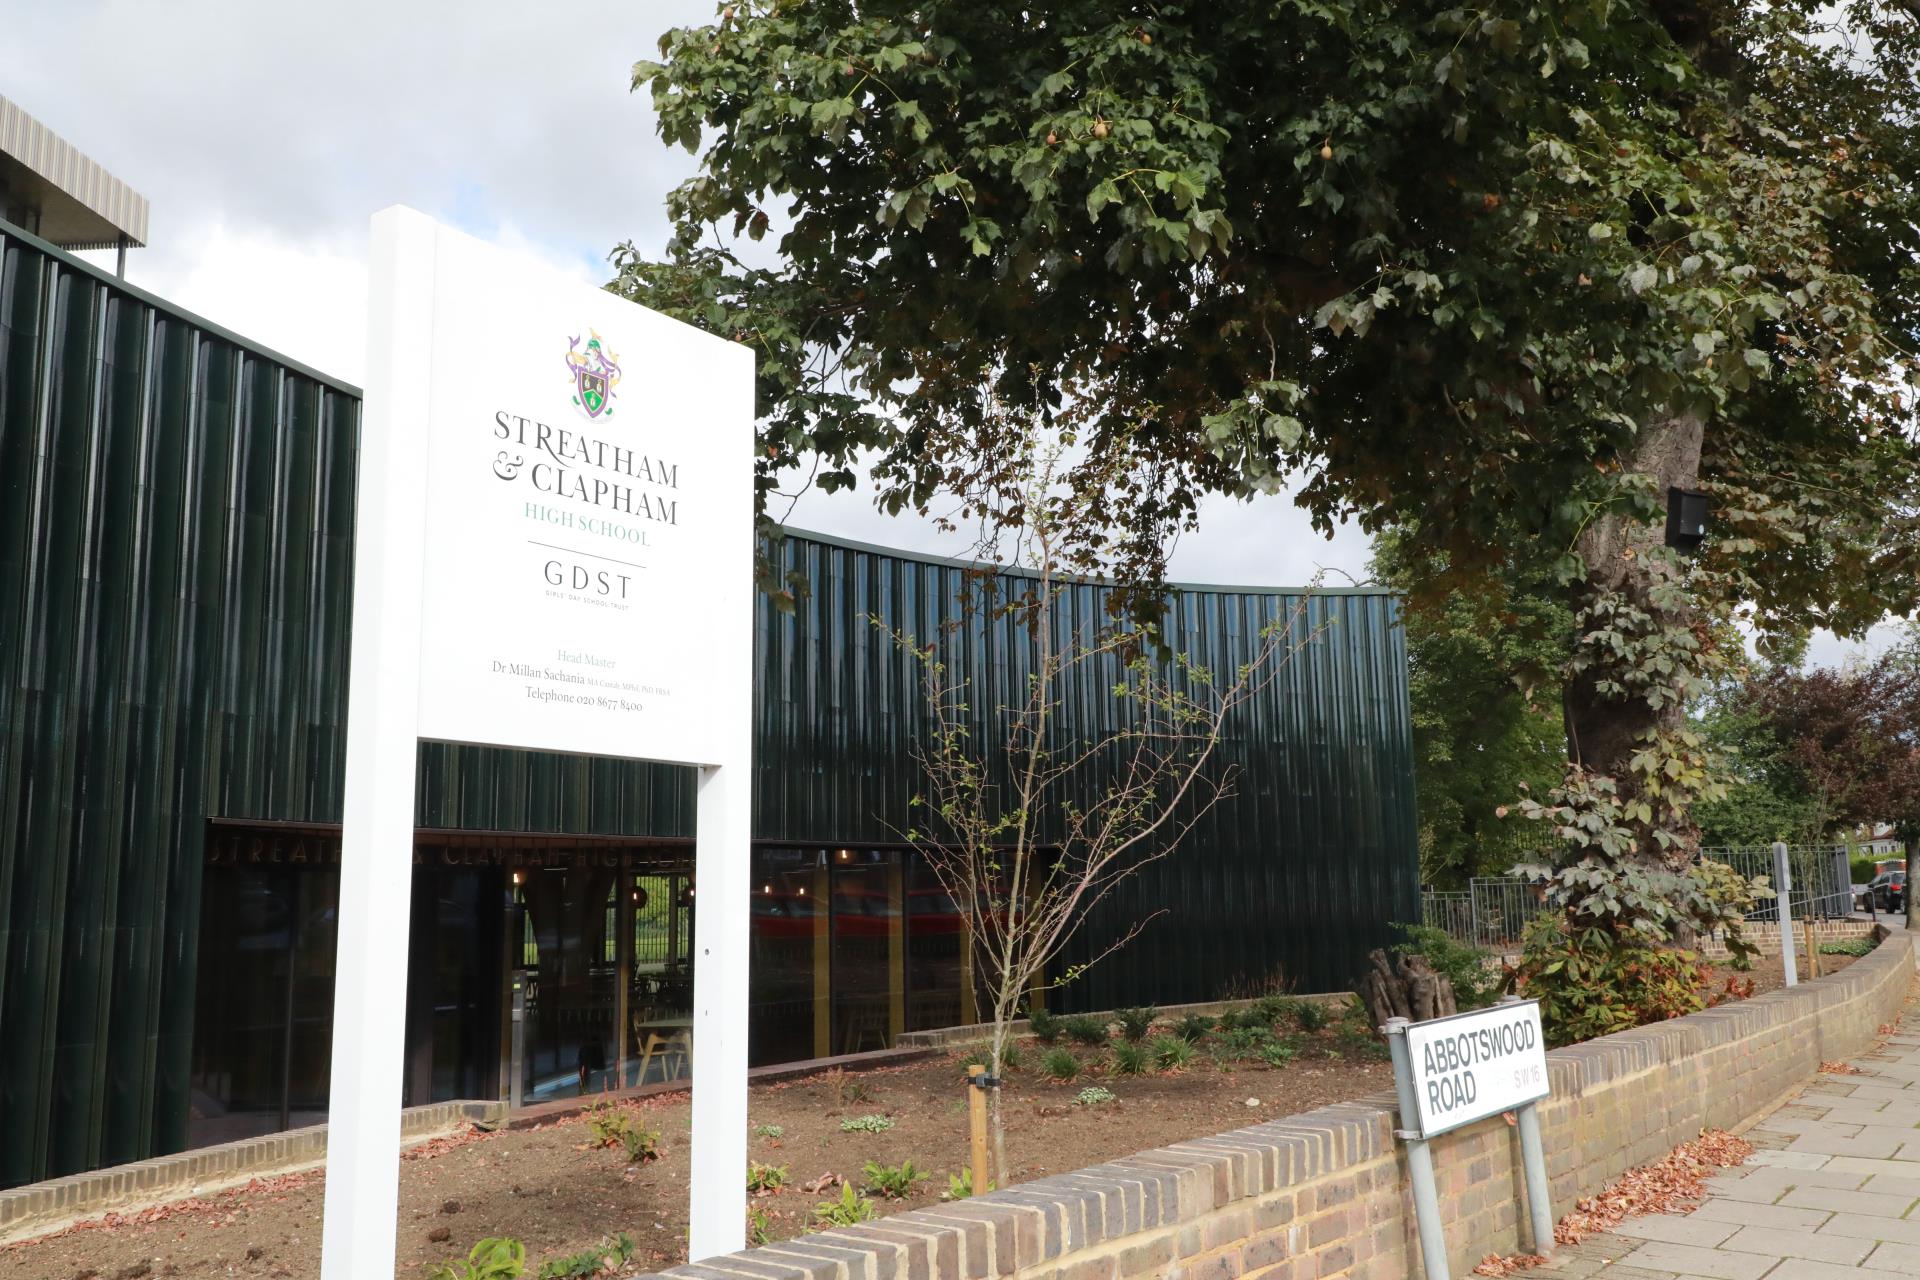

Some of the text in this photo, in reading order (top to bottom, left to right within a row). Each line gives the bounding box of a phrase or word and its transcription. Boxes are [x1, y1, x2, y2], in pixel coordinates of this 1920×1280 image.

[494, 410, 679, 489] STREATHAM
[493, 451, 678, 526] & CLAPHAM
[524, 502, 651, 547] HIGH SCHOOL
[492, 660, 506, 674] Dr
[509, 663, 541, 679] Millan
[543, 667, 585, 685] Sachania
[557, 649, 616, 669] Head Master
[525, 685, 643, 712] Telephone 020 8677 8400
[1424, 1019, 1535, 1077] ABBOTSWOOD
[1427, 1070, 1477, 1116] ROAD
